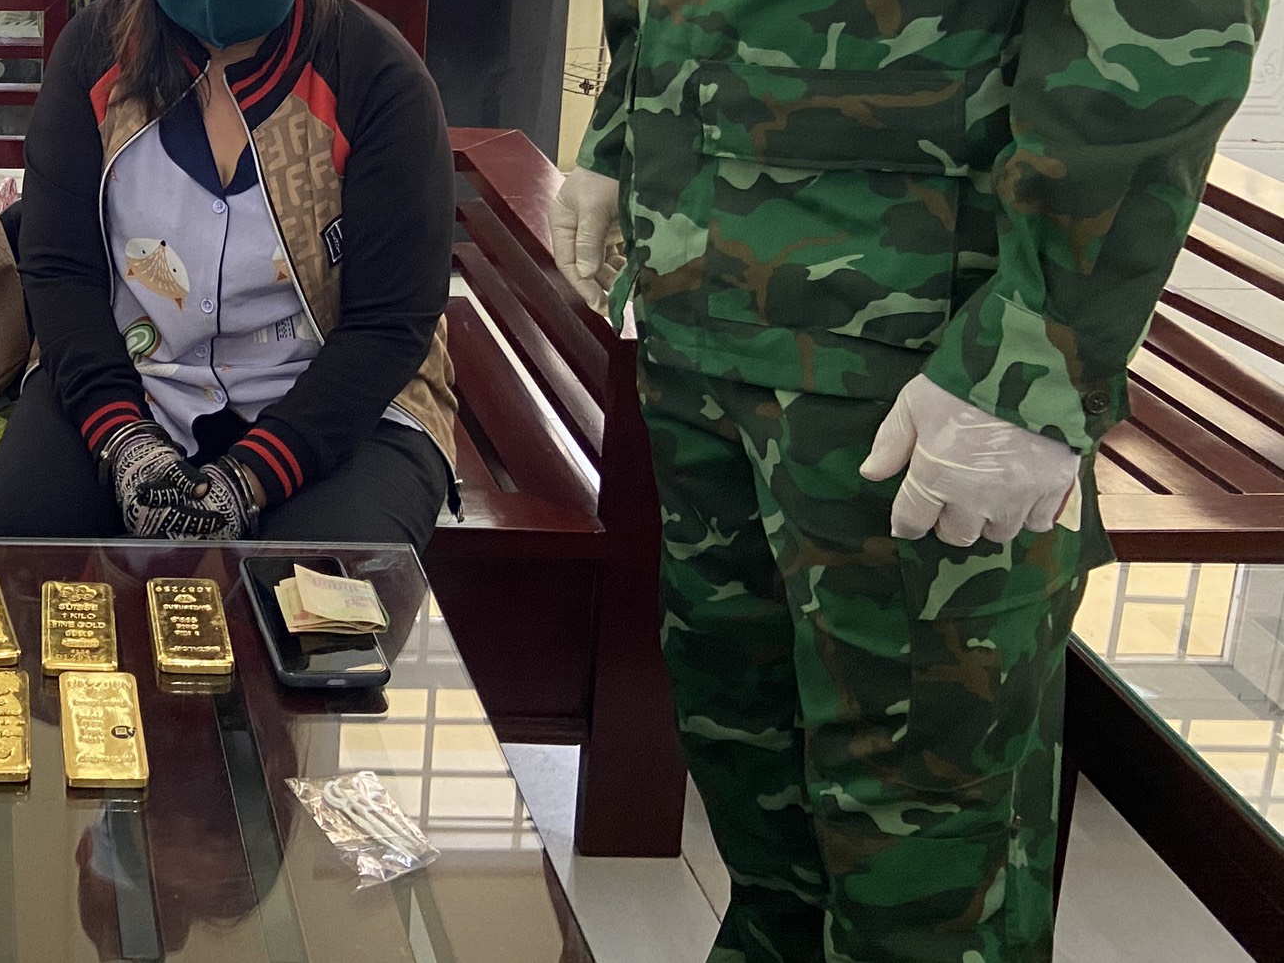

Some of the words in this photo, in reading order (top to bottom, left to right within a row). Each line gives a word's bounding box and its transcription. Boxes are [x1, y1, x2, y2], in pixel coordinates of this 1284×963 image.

[58, 602, 99, 611] SUISSE
[70, 612, 97, 620] KILO
[51, 620, 76, 628] FINE
[77, 621, 106, 629] GOLD
